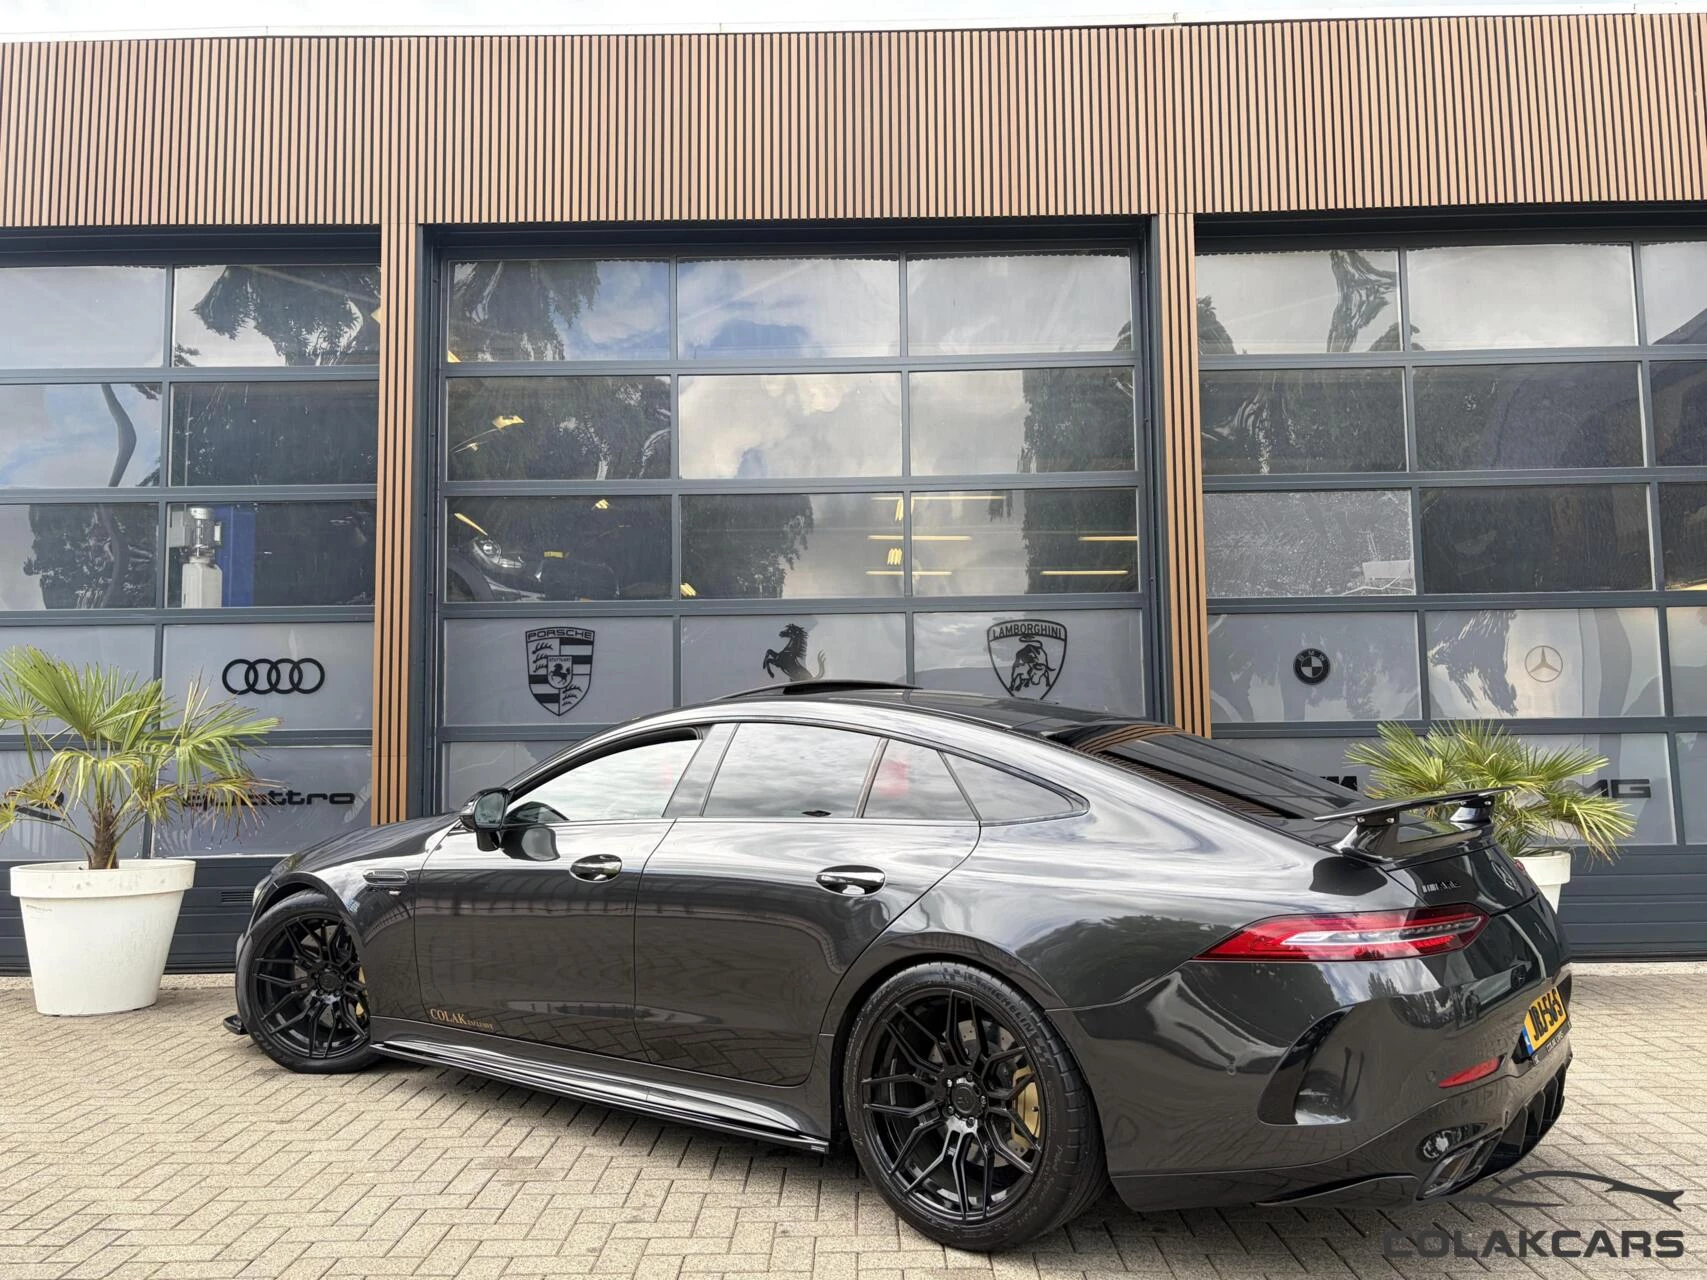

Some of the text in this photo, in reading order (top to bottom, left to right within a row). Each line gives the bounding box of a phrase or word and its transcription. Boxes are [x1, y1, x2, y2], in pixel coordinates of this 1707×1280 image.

[527, 629, 593, 640] PORSCHE
[992, 623, 1062, 639] LAMBORGHINI
[430, 1008, 467, 1024] COLAK
